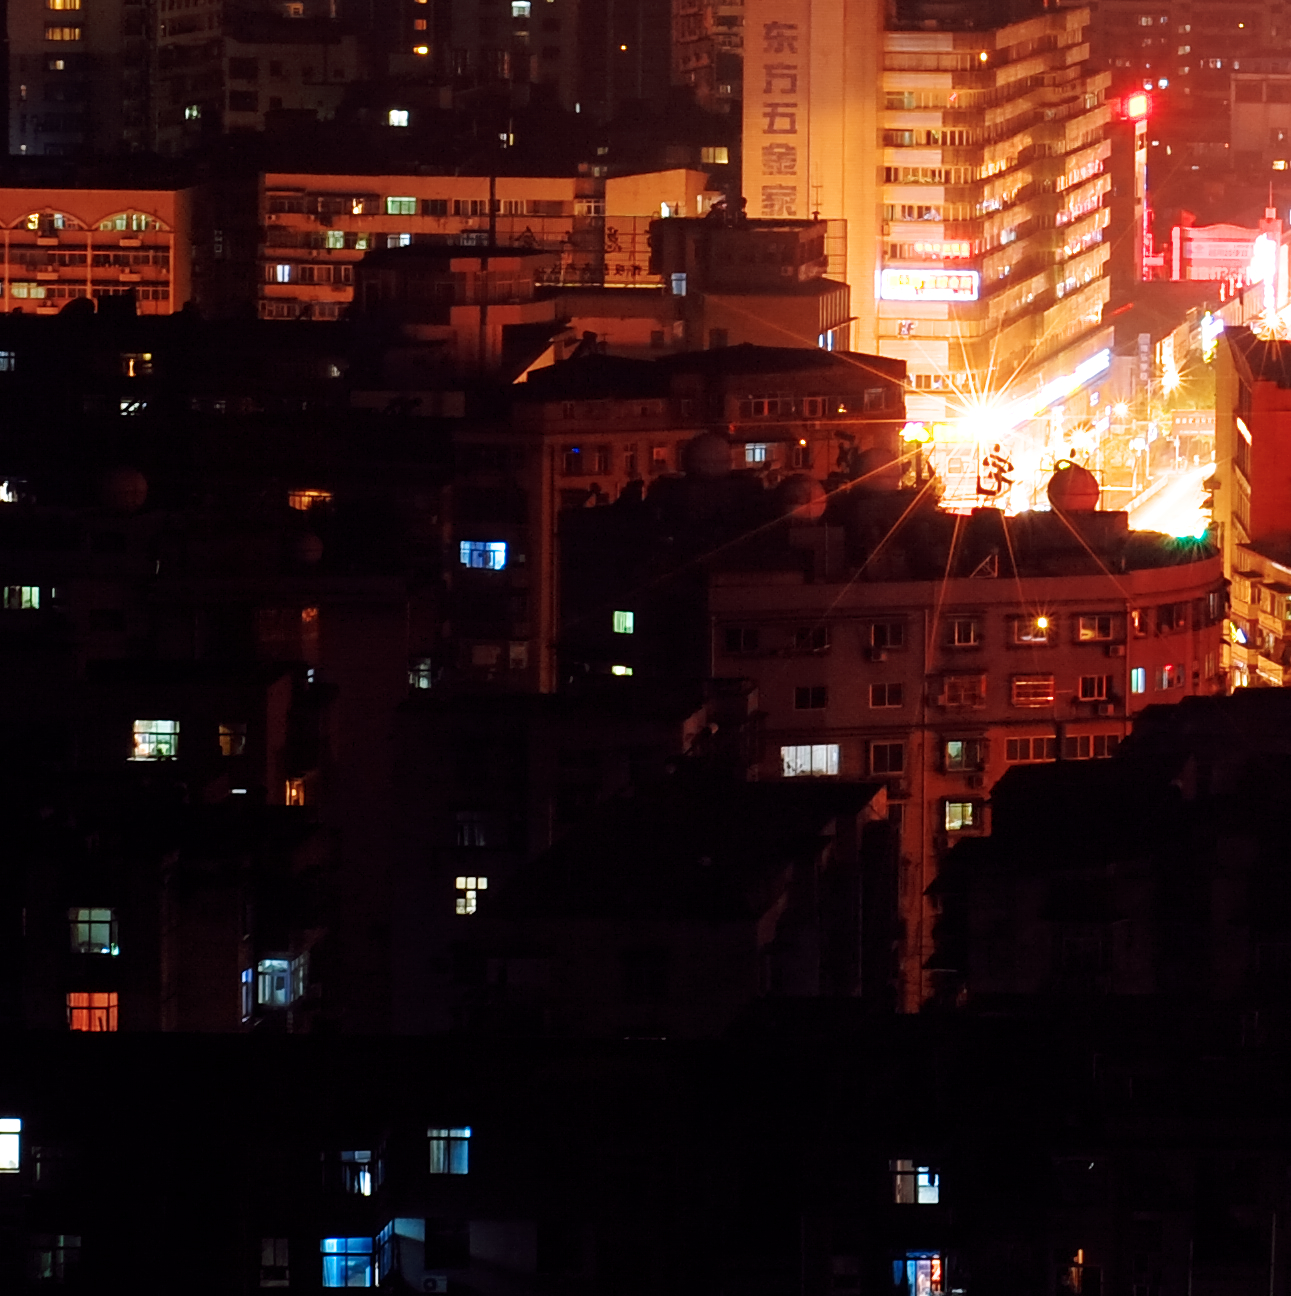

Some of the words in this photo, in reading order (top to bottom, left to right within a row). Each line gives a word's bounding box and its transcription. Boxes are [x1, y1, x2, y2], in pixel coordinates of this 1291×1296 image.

[762, 21, 798, 216] 东方五金家
